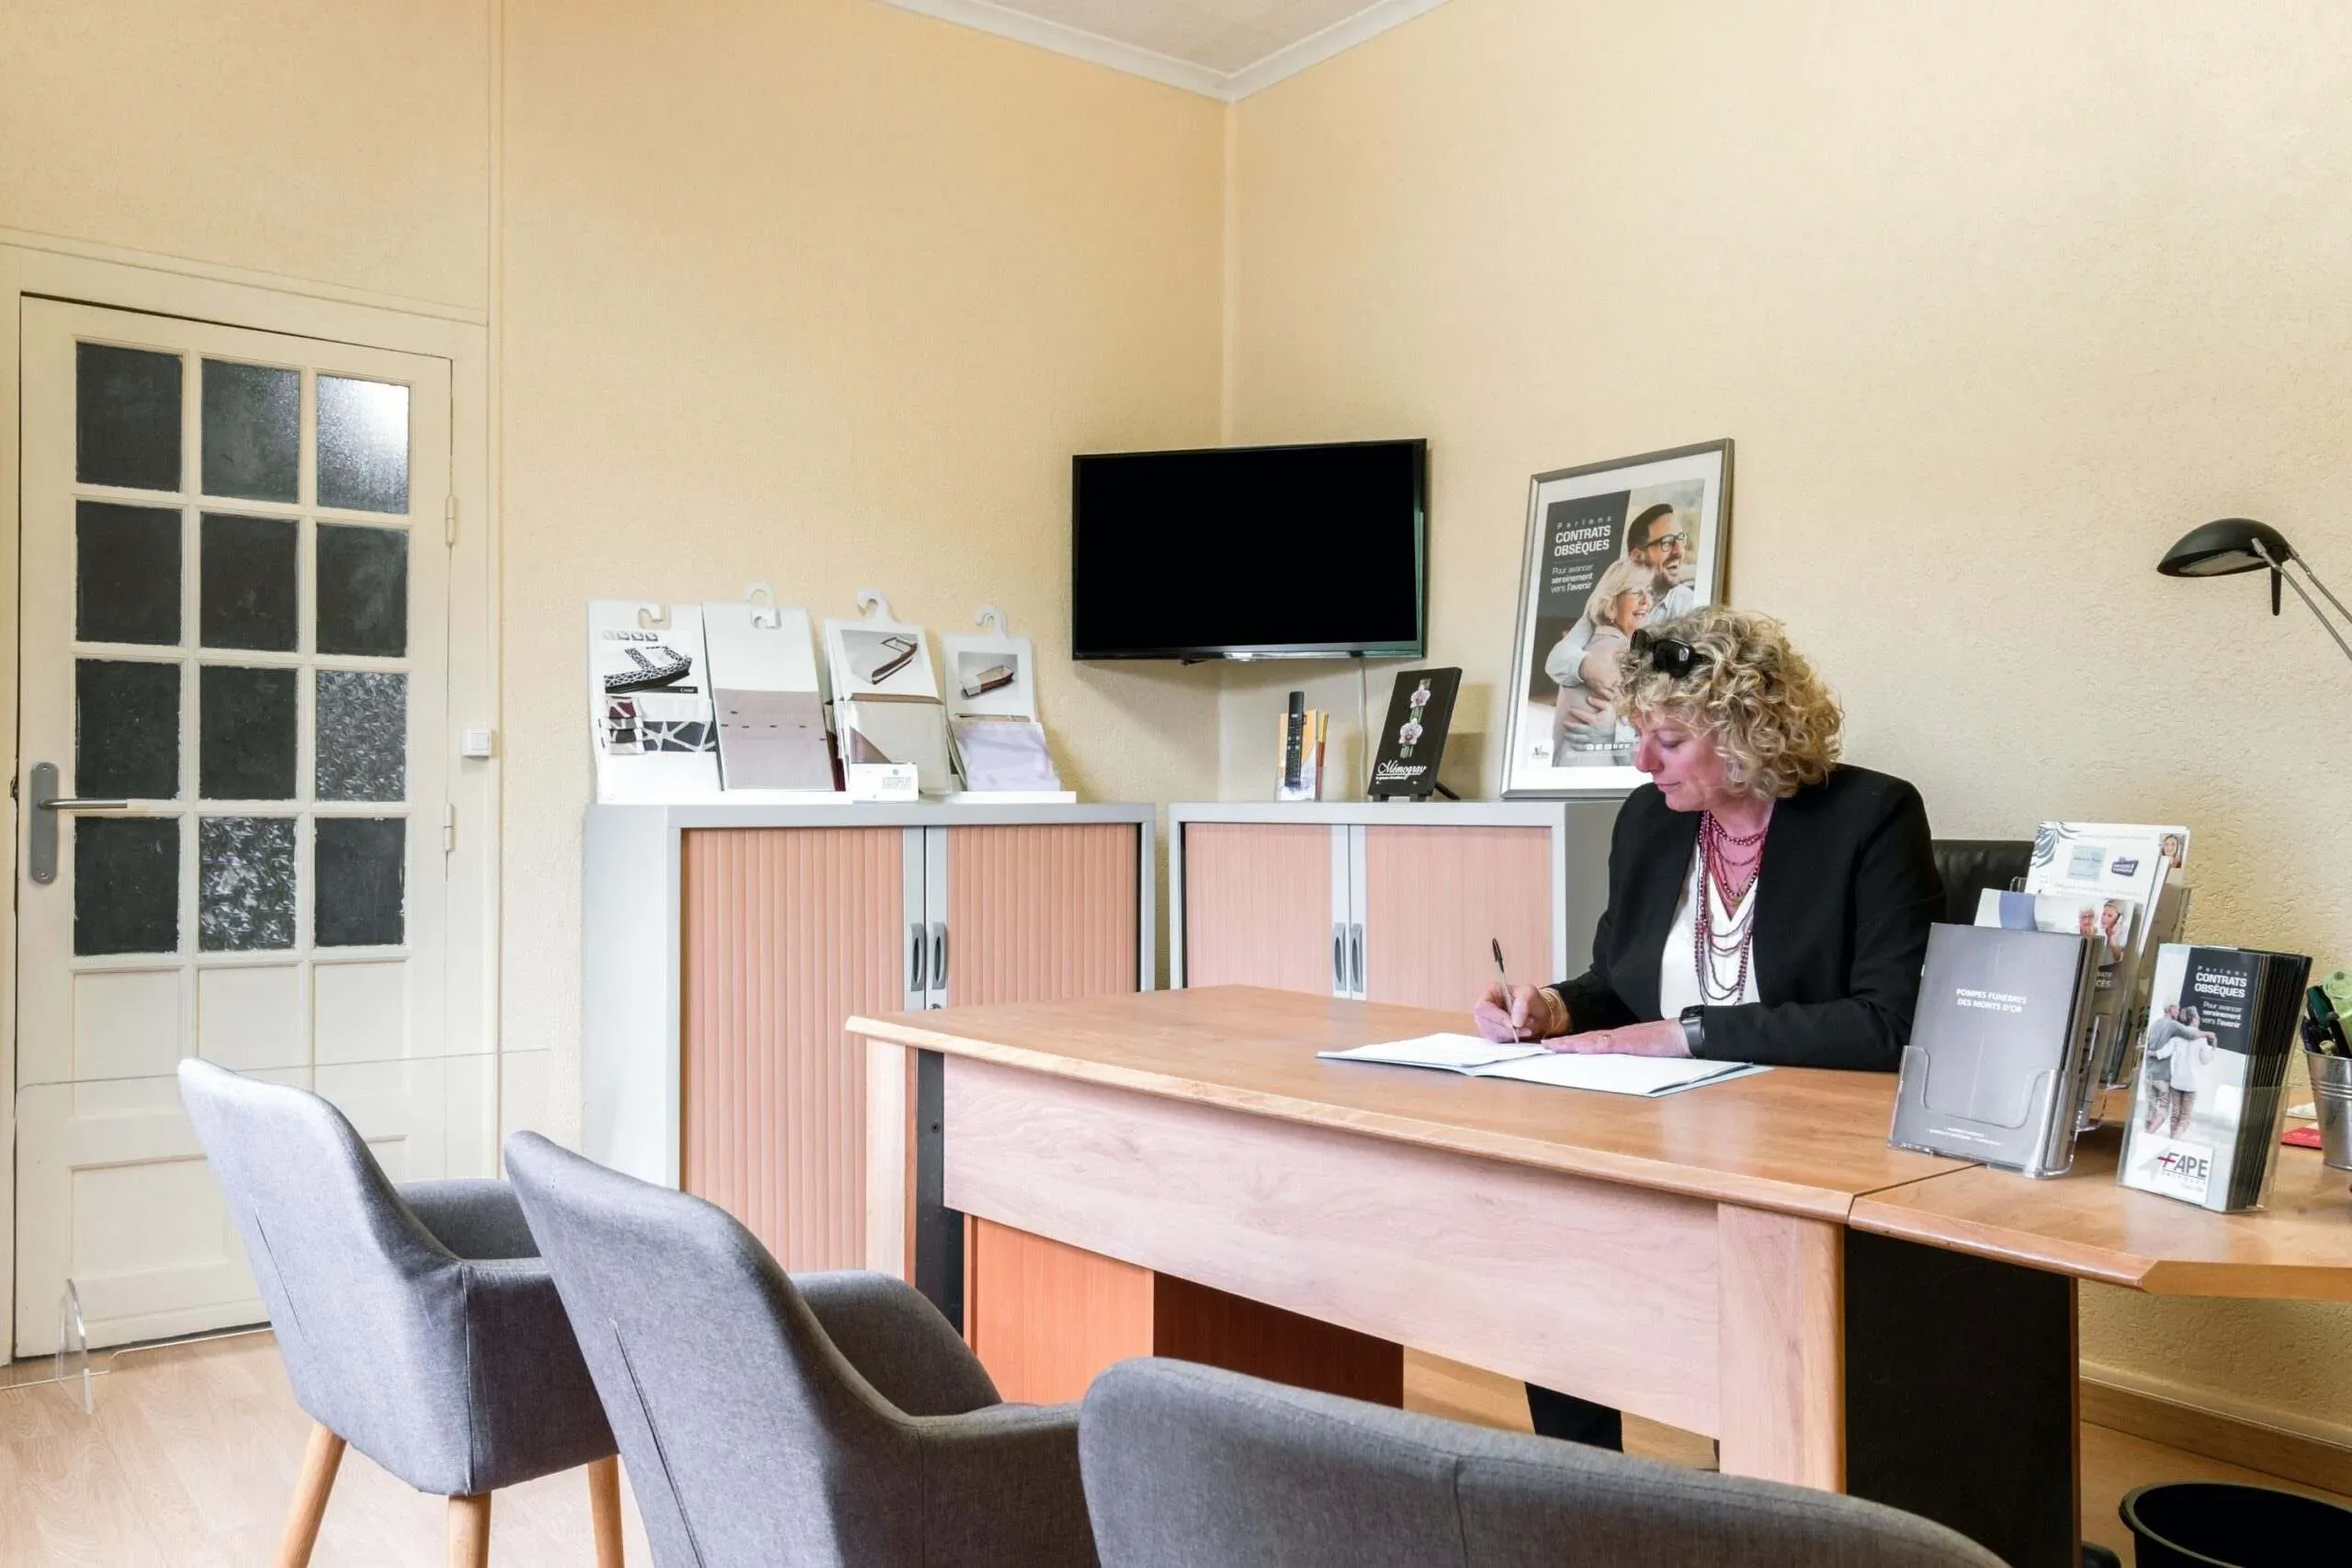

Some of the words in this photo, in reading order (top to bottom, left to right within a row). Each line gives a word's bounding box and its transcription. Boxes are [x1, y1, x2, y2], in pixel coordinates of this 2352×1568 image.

[1555, 525, 1611, 544] CONTRATS
[2195, 972, 2247, 987] CONTRATS
[1955, 987, 1987, 999] POMPES
[1956, 998, 1973, 1008] DES
[1973, 999, 2001, 1010] MONTS
[2002, 1003, 2022, 1013] D'OR
[2157, 1152, 2209, 1178] FAPE
